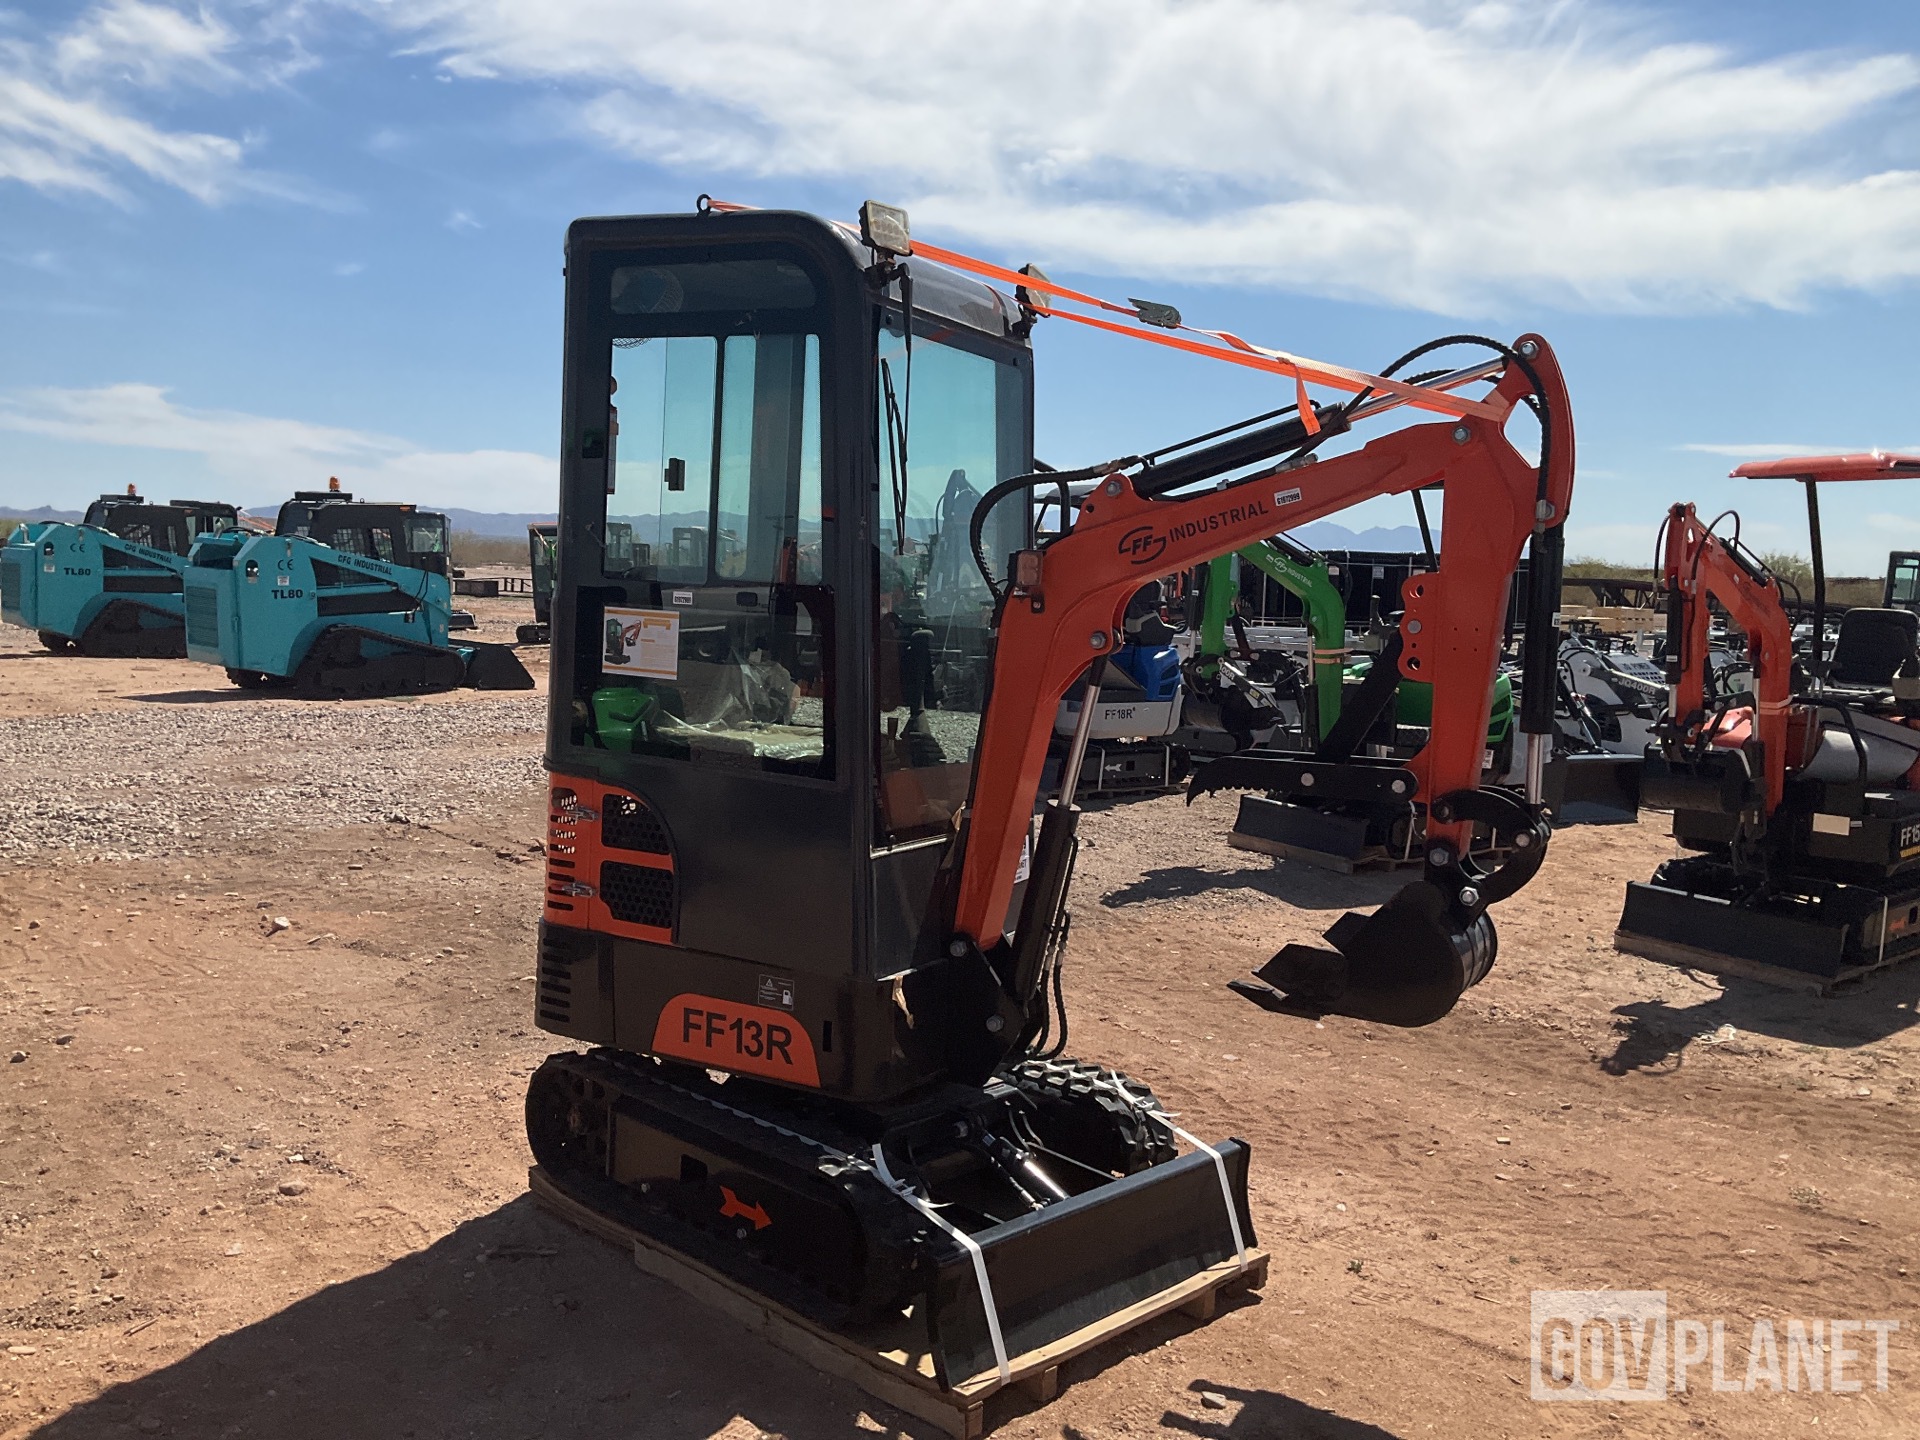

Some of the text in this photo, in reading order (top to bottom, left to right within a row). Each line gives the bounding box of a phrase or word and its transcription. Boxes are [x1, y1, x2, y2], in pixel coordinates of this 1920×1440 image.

[1169, 501, 1269, 542] INDUSTRIAL
[138, 548, 173, 563] INDUSTRIAL
[63, 567, 92, 576] TL80
[277, 559, 294, 570] CE
[337, 554, 393, 575] CFG INDUSTRIAL
[1287, 567, 1313, 587] INDUSTRIAL
[271, 589, 304, 600] TL80
[1618, 678, 1656, 695] JQ400R
[682, 1007, 794, 1065] FF13R
